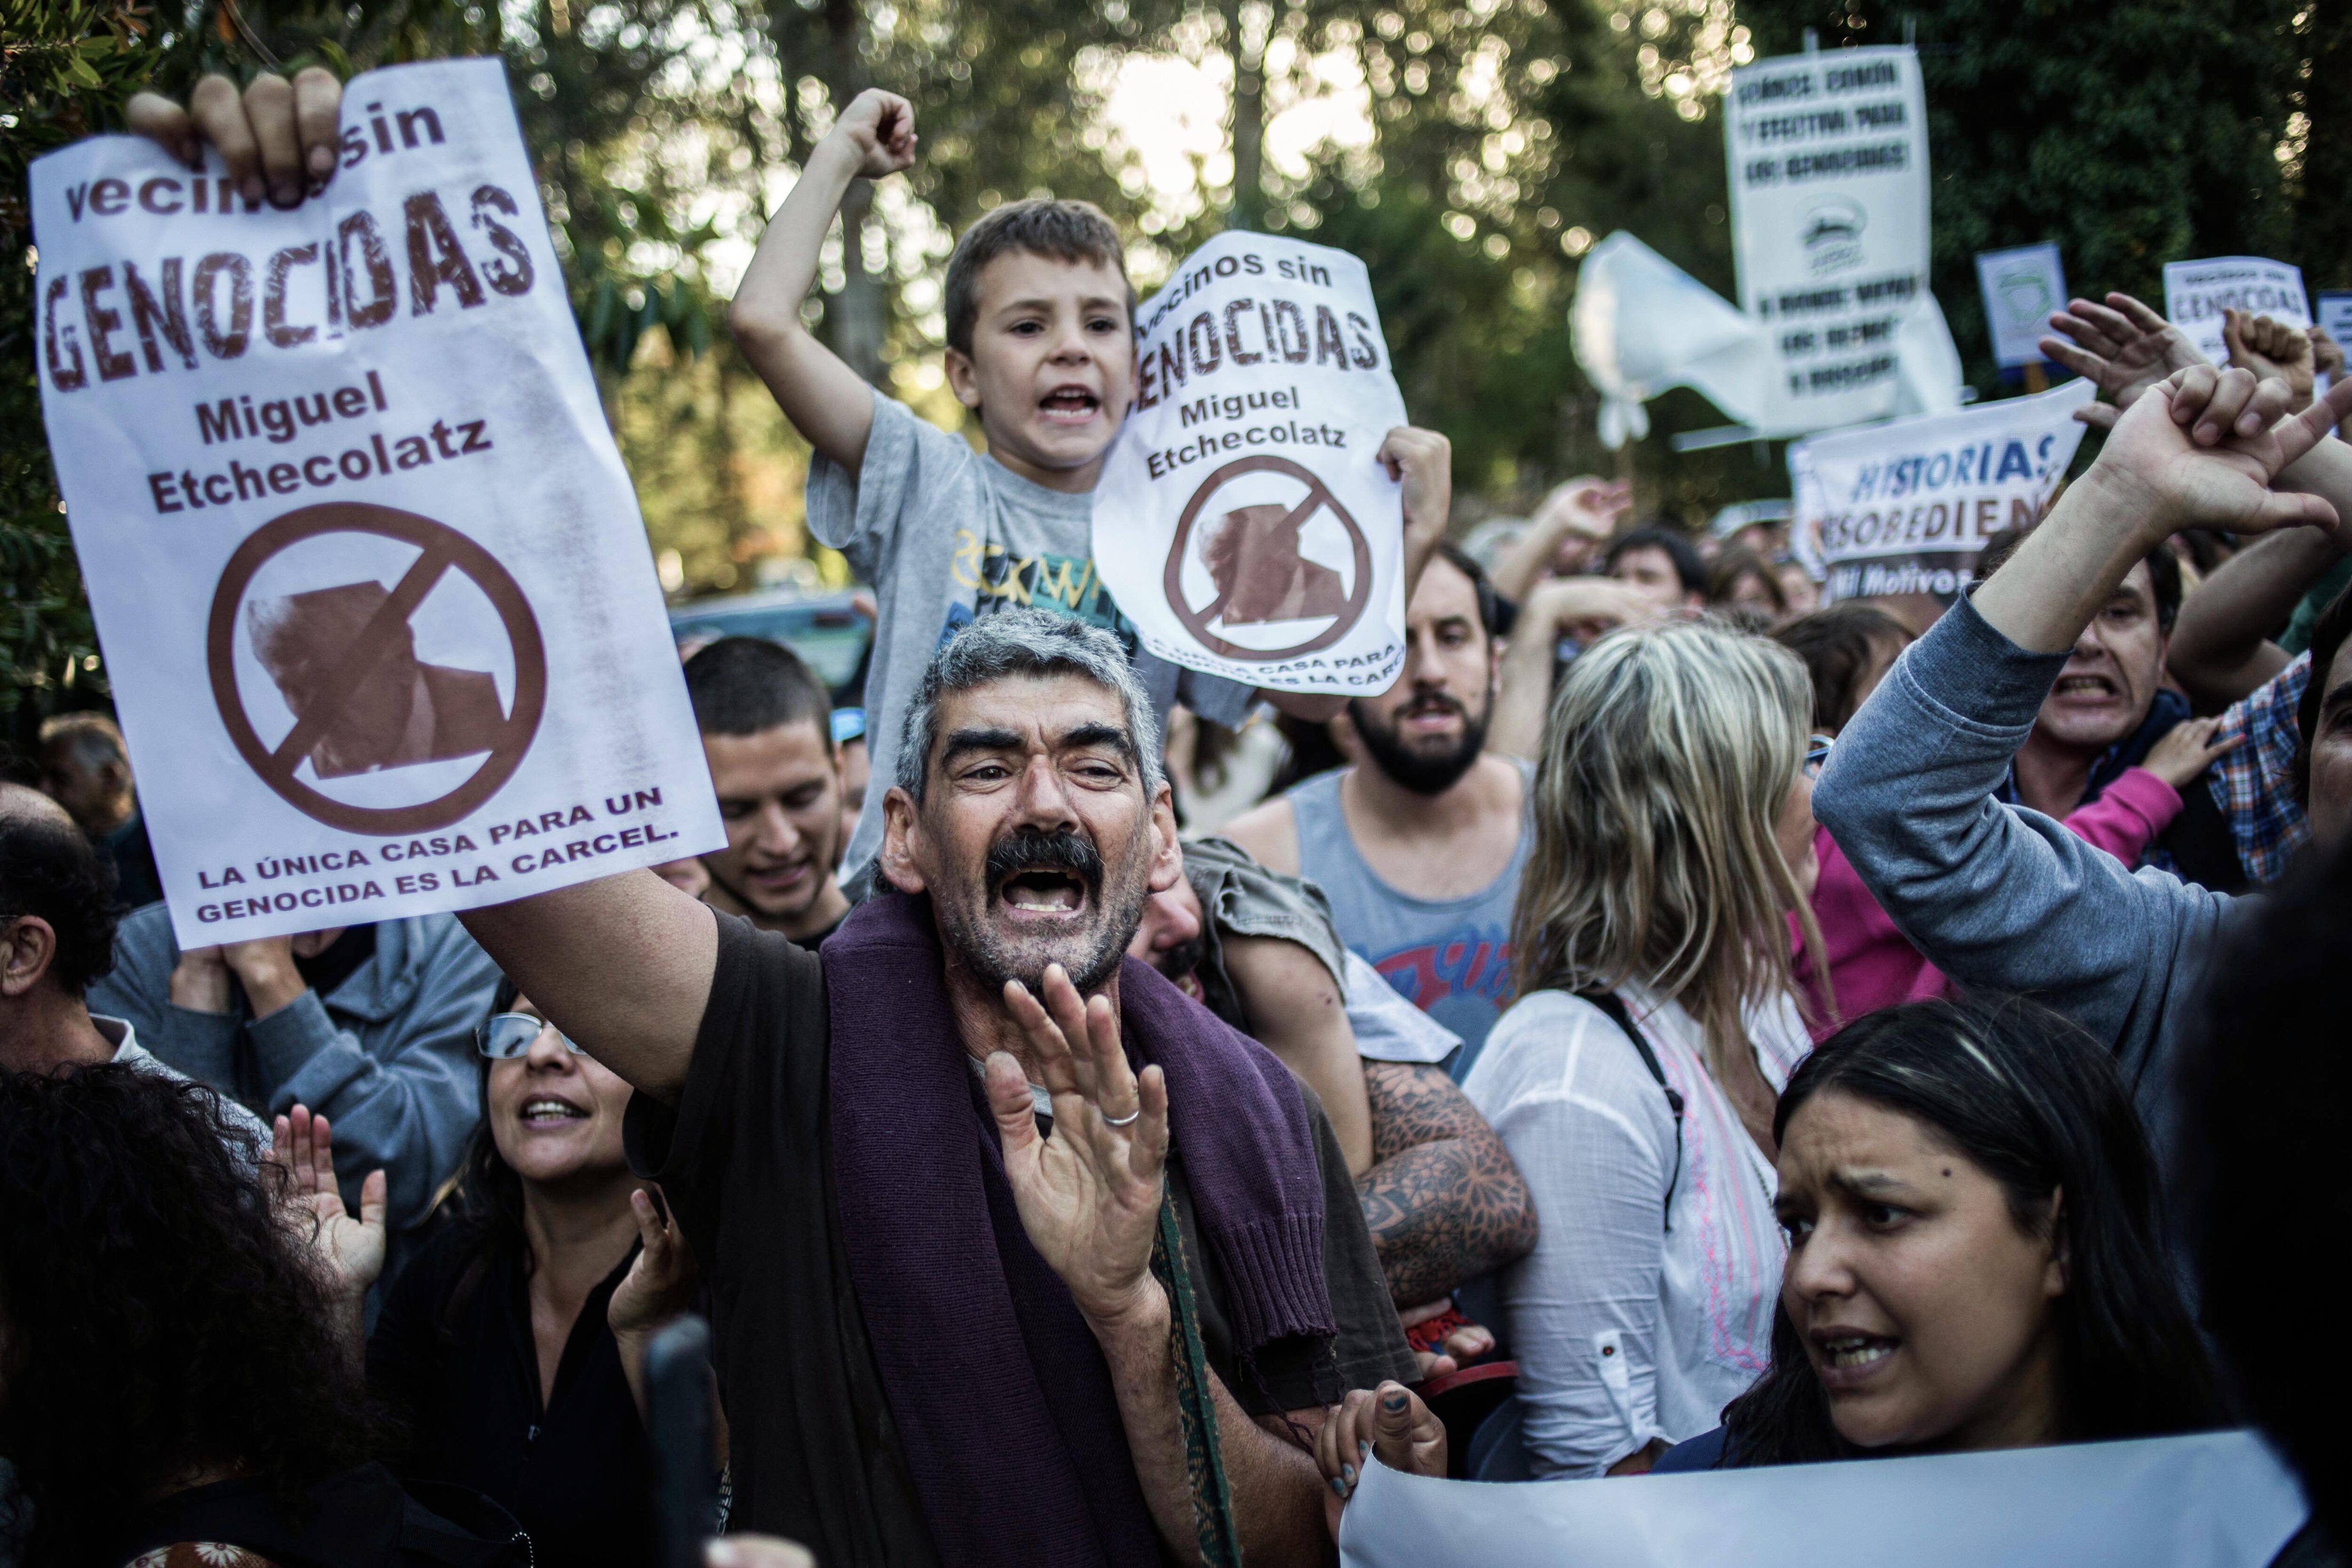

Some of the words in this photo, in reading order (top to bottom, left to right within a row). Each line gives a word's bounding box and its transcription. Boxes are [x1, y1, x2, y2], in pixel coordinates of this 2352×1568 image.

[341, 102, 445, 169] sin
[44, 184, 535, 393] GENOCIDAS
[1137, 253, 1265, 340] vecinos
[1277, 255, 1332, 287] sin
[1136, 298, 1379, 413] ENOCIDAS
[195, 370, 389, 445] Miguel
[1180, 386, 1300, 428] Miguel
[148, 416, 493, 514] Etchecolatz
[1147, 421, 1346, 481] Etchecolatz
[1258, 659, 1327, 674] CASA
[1334, 644, 1395, 669] PARA
[1308, 675, 1340, 685] LA
[197, 879, 386, 924] GENOCIDA
[395, 872, 439, 895] ES
[453, 864, 500, 887] LA
[511, 824, 679, 873] CARCEL.
[198, 866, 246, 890] LA
[256, 848, 371, 879] ÚNICA
[381, 834, 478, 863] CASA
[489, 804, 595, 845] PARA
[605, 787, 663, 817] UN
